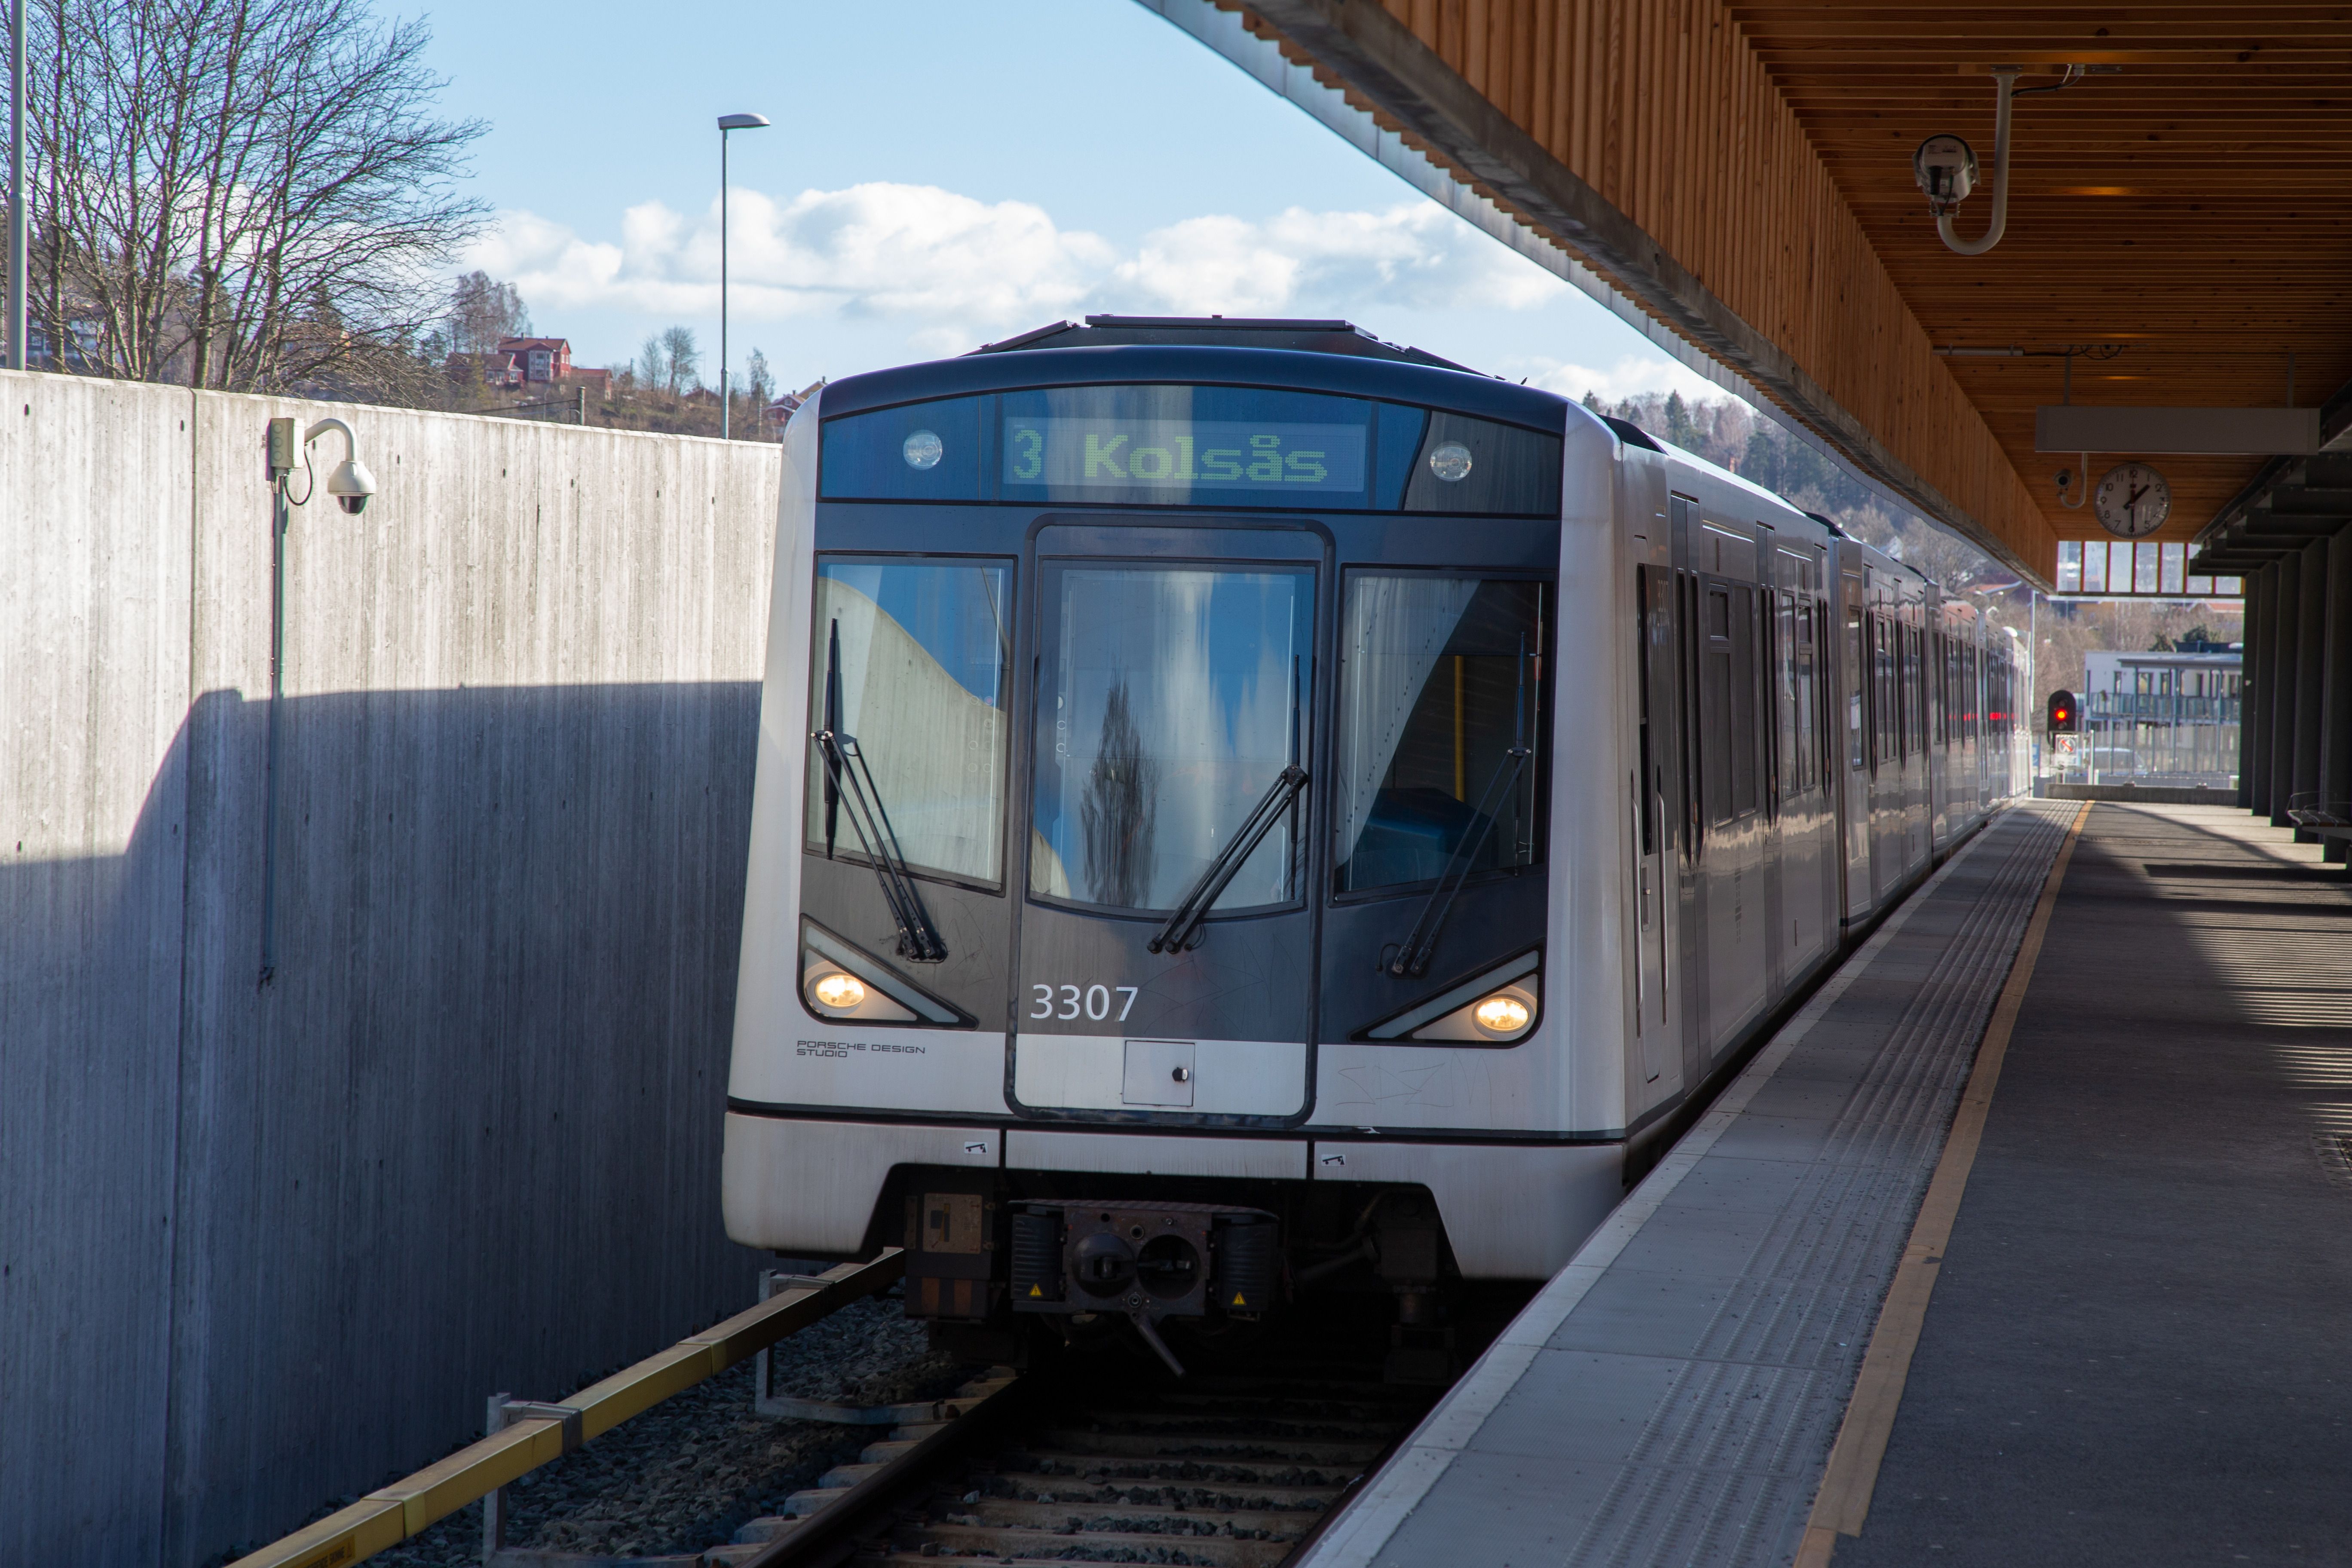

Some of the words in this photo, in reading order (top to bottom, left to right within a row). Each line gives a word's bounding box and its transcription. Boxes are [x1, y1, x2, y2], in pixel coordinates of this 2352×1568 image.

[1014, 429, 1042, 478] 3
[1084, 434, 1327, 482] Kolsås
[2106, 483, 2113, 491] 10
[2101, 496, 2107, 505] 9
[2104, 510, 2110, 518] 8
[2115, 520, 2121, 529] 7
[1031, 984, 1138, 1021] 3307
[797, 1041, 866, 1050] PORSCHE
[871, 1044, 925, 1054] DESIGN
[797, 1049, 847, 1057] STUDIO
